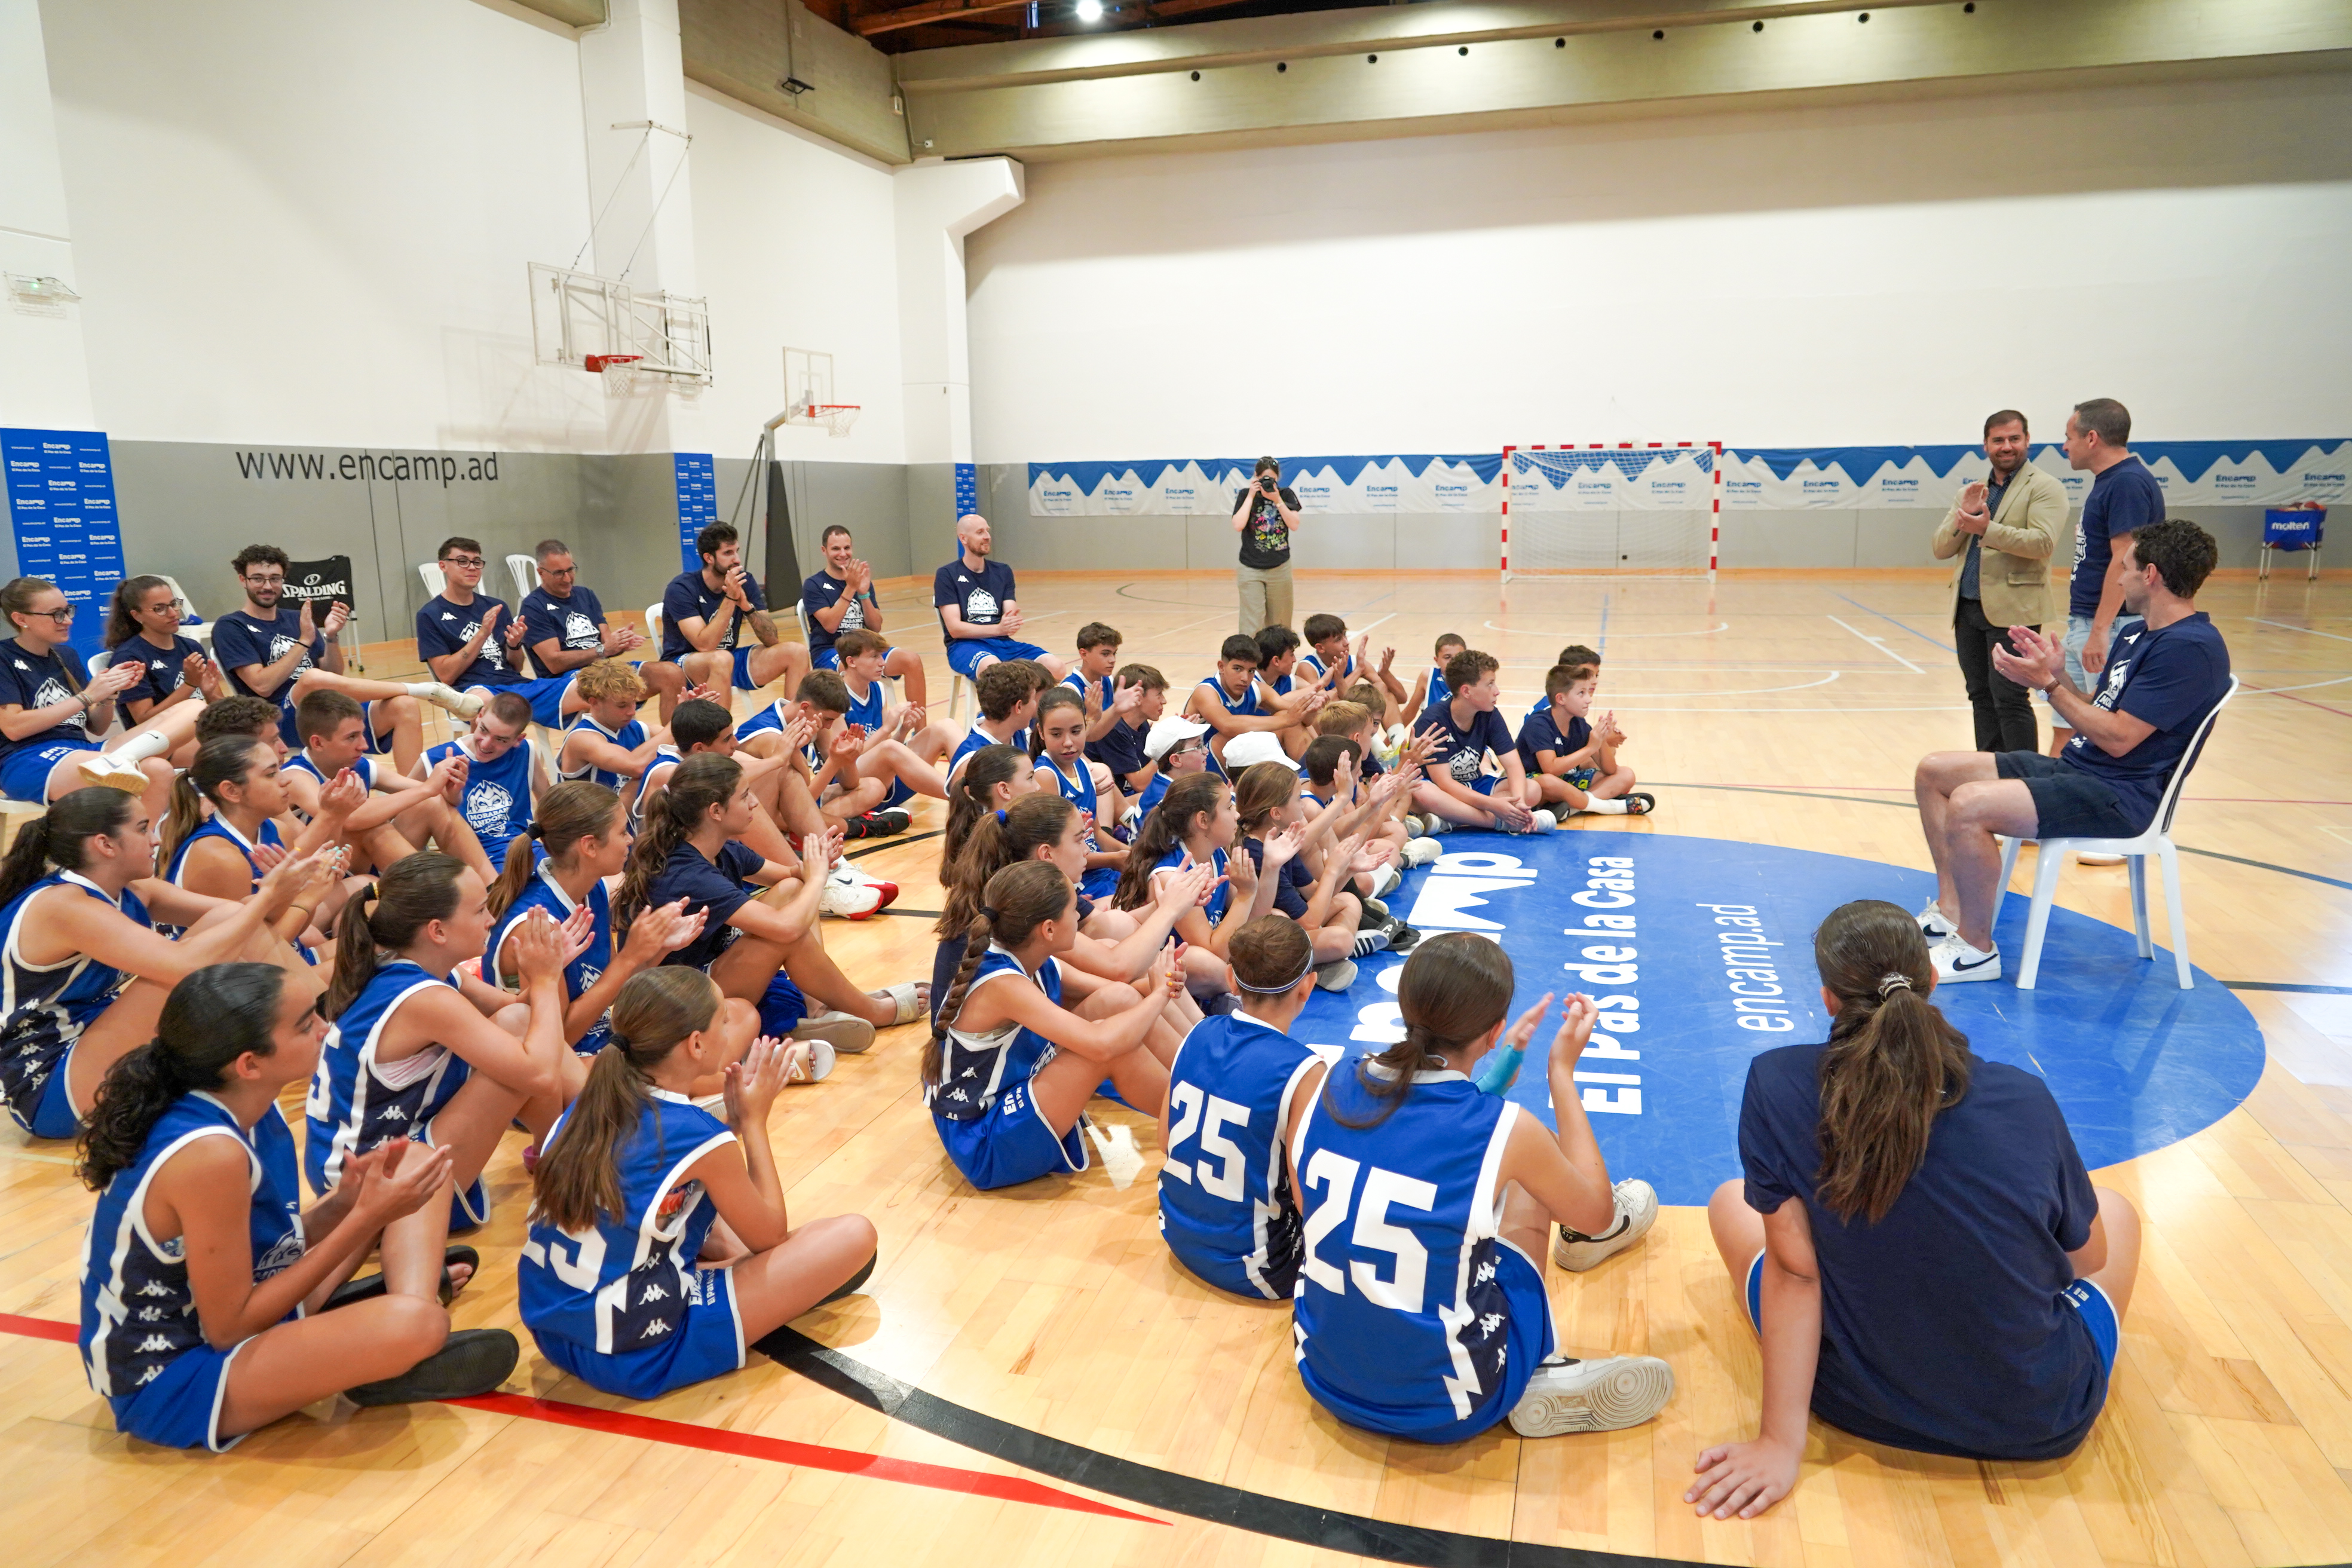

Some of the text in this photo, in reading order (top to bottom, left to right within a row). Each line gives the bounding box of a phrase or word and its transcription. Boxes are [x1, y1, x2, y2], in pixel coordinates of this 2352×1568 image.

[235, 451, 498, 488] www.encamp.ad
[2272, 521, 2310, 531] molten
[282, 580, 347, 598] SPALDING
[1571, 856, 1636, 908] Casa
[1564, 914, 1637, 938] la
[1564, 945, 1639, 985] de
[1696, 903, 1794, 1032] encamp.ad
[1165, 1079, 1251, 1202] 25
[1304, 1147, 1438, 1314] 25
